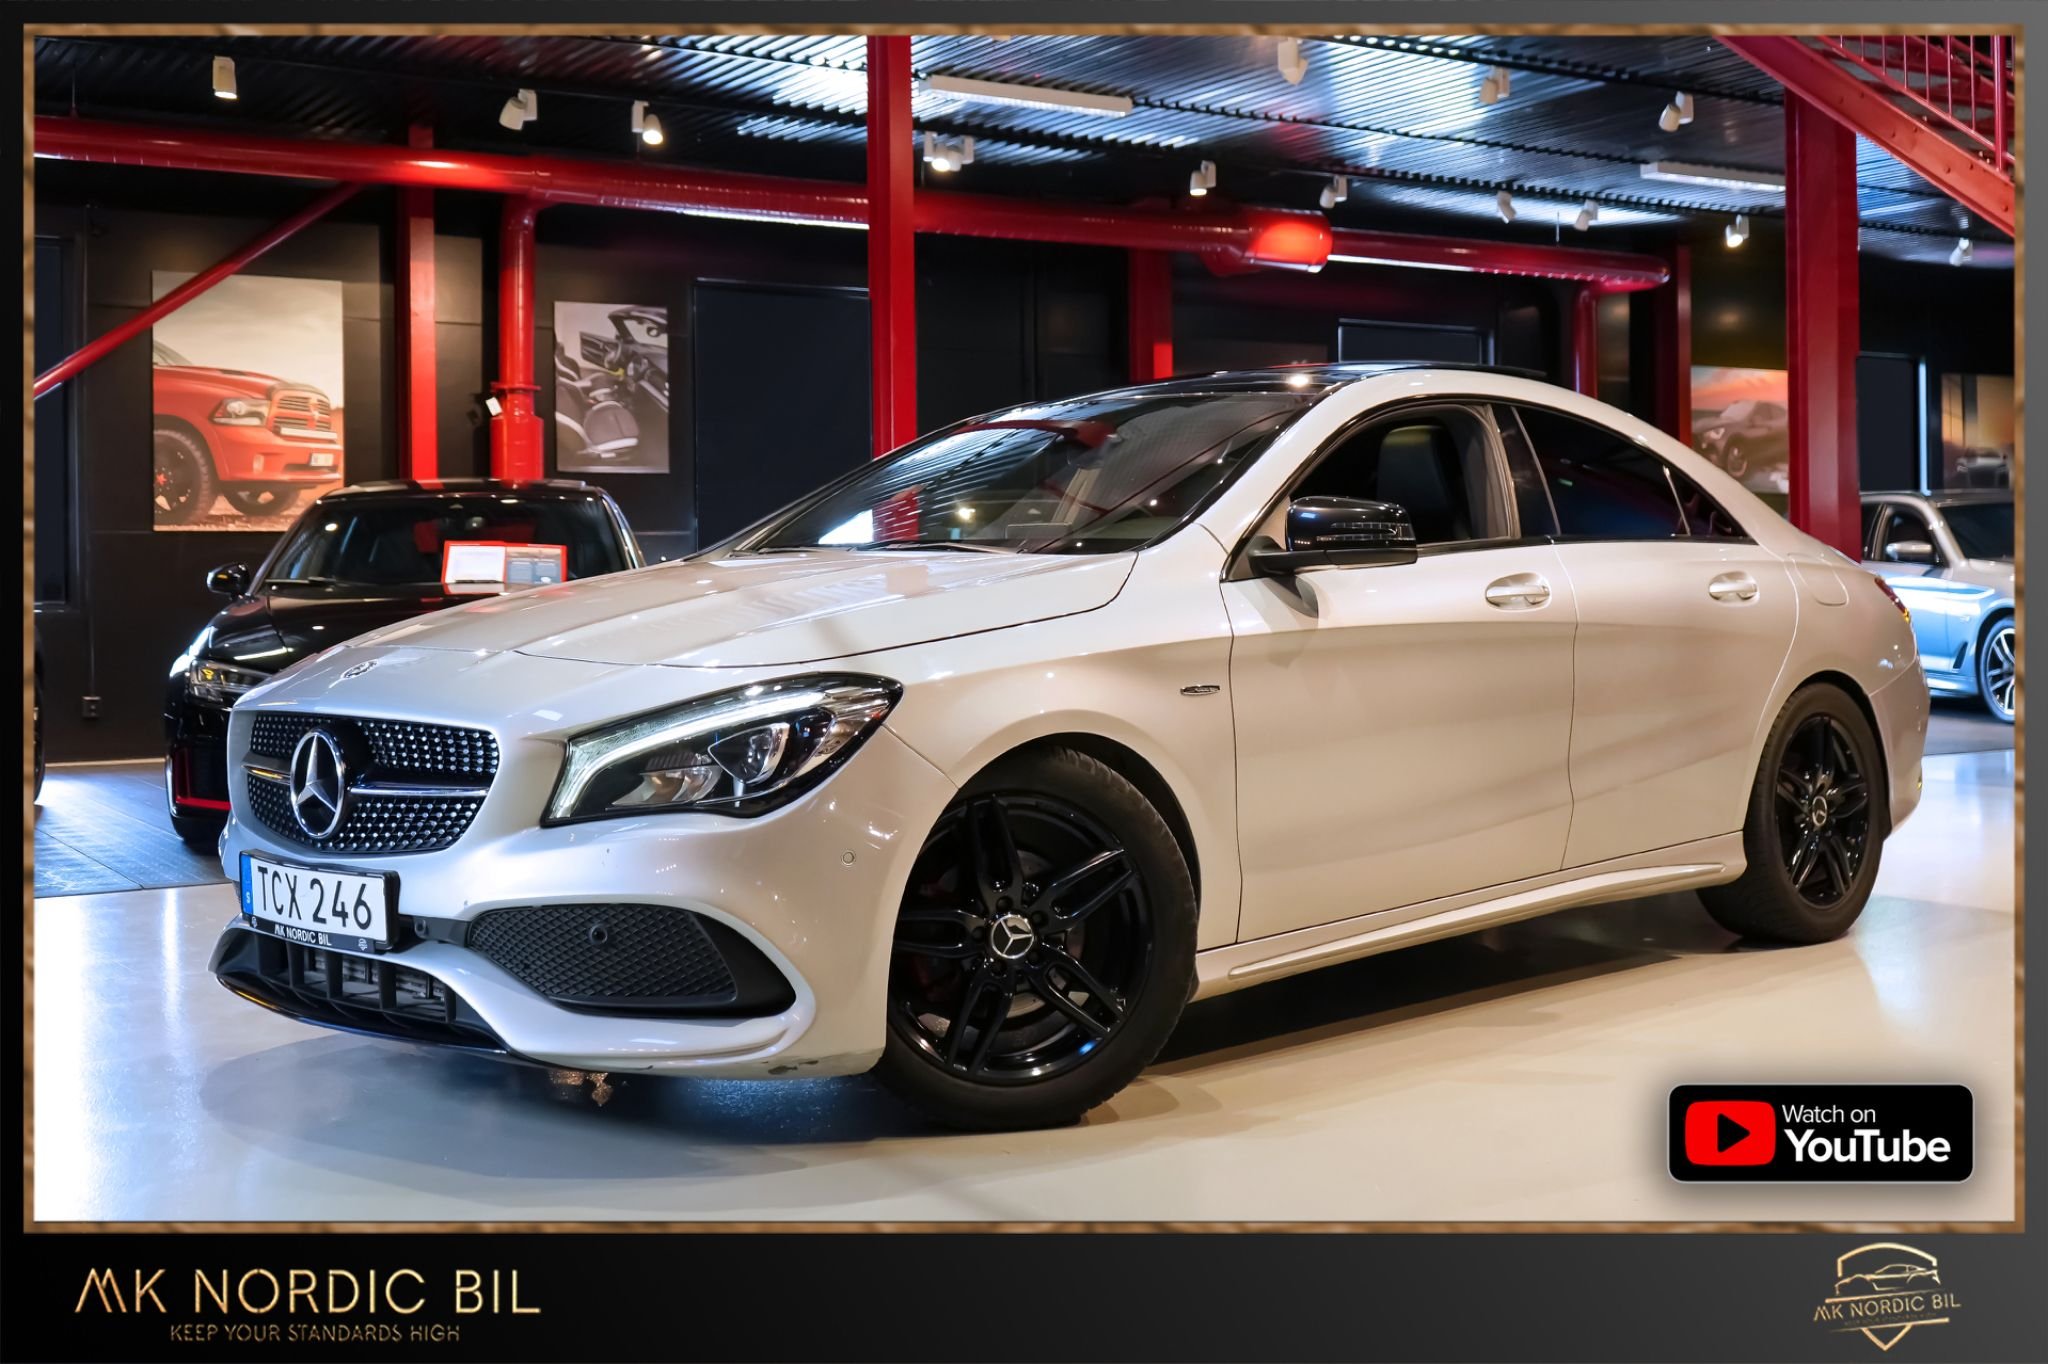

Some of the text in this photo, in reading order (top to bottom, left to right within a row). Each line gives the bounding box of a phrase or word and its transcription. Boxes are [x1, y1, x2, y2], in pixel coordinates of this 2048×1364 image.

[257, 866, 372, 930] TCX 246
[286, 926, 317, 944] NORDIC
[318, 932, 332, 946] BIL
